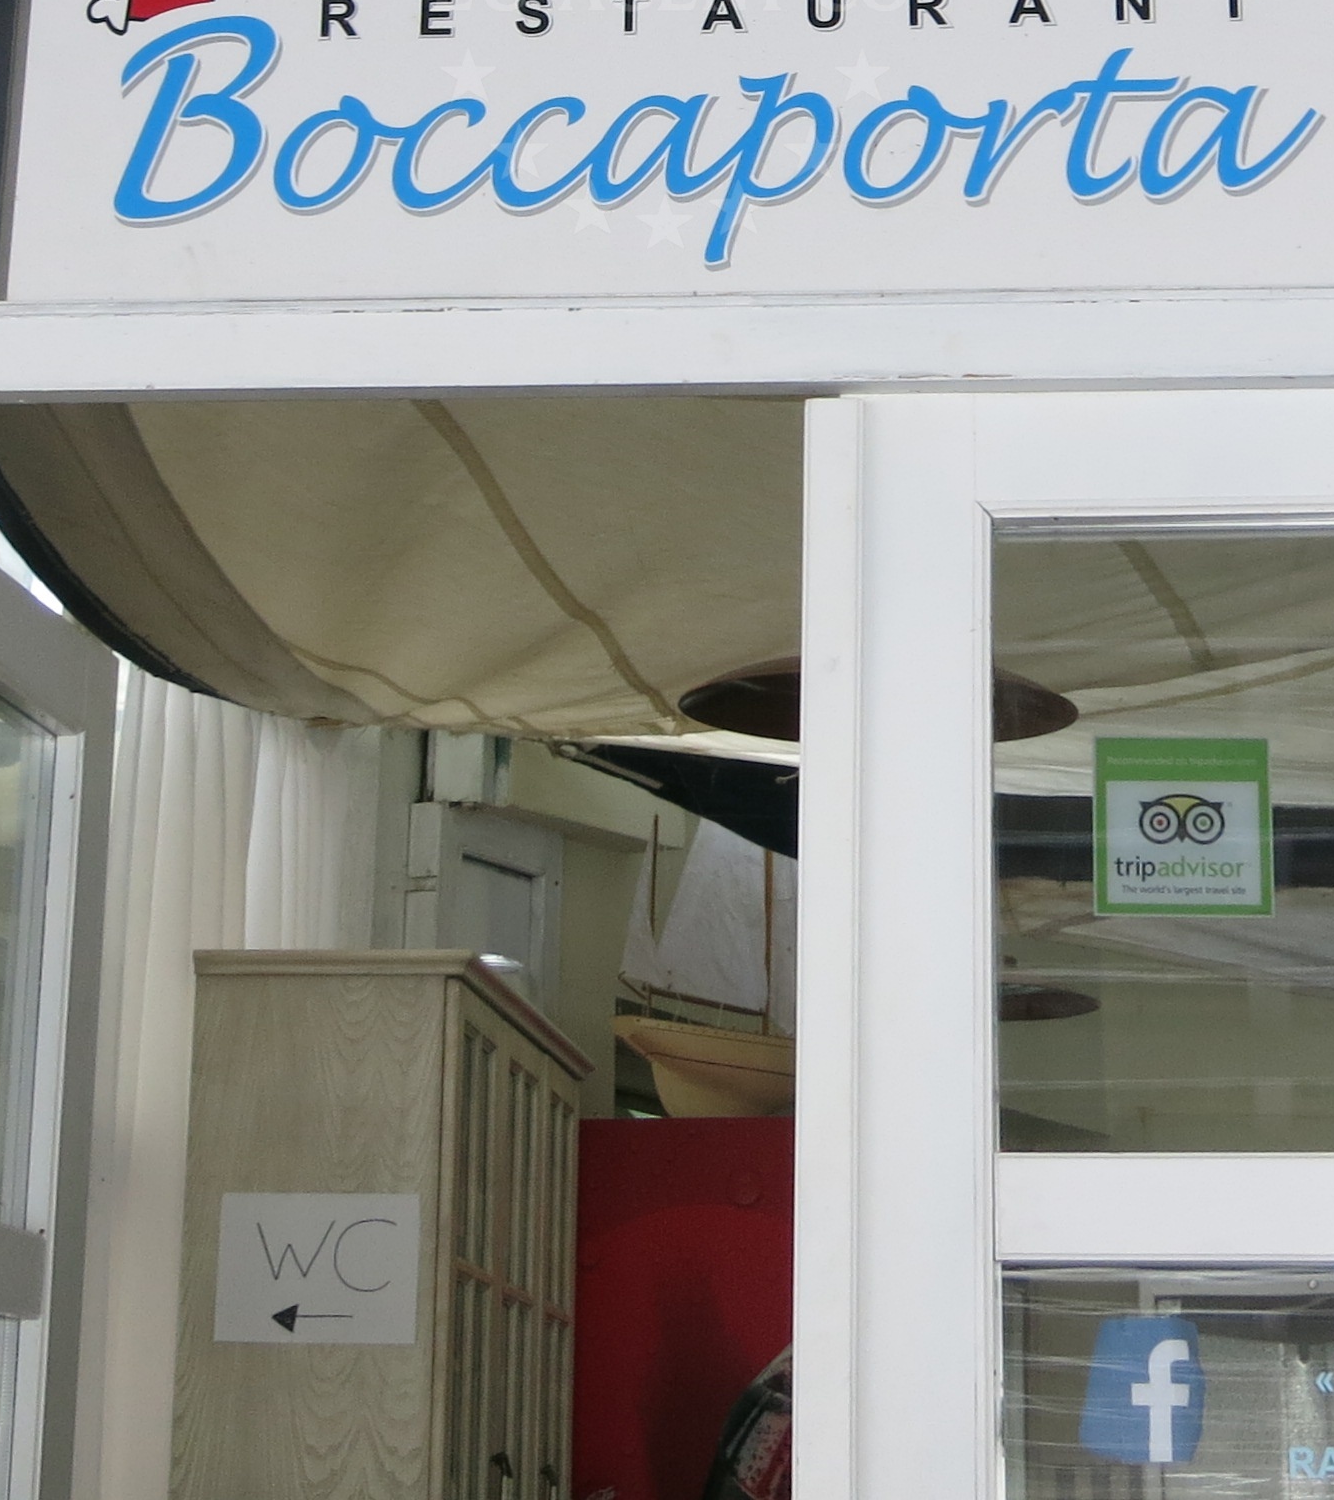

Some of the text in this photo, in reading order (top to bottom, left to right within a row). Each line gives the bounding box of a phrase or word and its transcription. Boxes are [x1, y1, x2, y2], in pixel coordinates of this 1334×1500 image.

[113, 15, 1317, 268] Boccaporta
[1114, 855, 1245, 882] tripadvisor
[256, 1218, 398, 1293] WC
